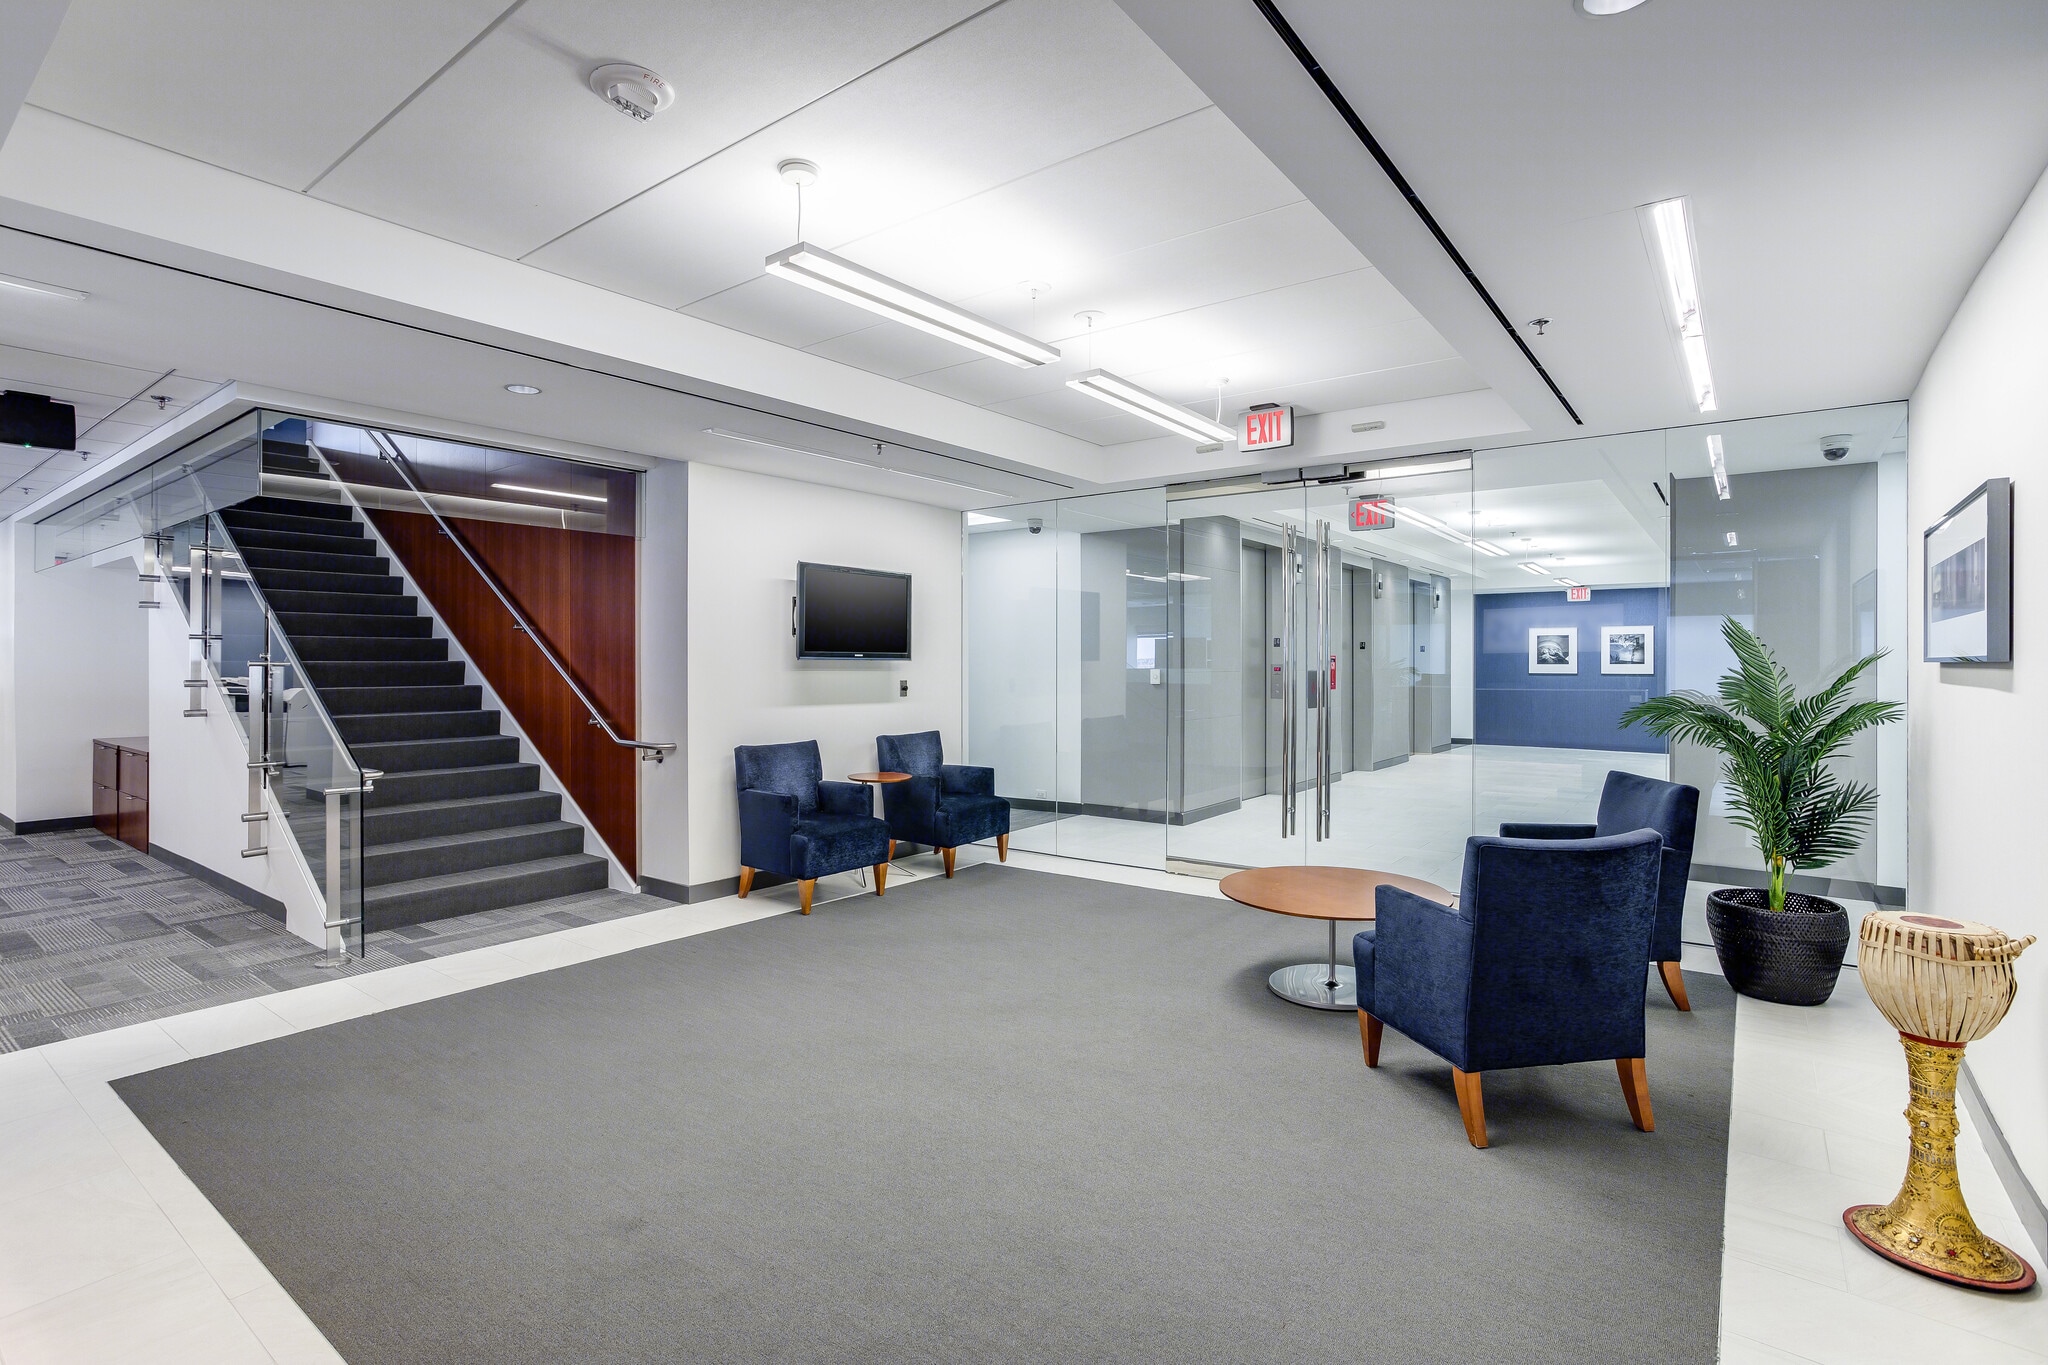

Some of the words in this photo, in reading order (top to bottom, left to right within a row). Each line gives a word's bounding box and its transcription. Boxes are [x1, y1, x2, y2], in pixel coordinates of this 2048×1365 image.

[643, 74, 665, 88] FIRE
[1246, 410, 1284, 445] EXIT
[1355, 499, 1387, 527] EXIT
[1571, 587, 1588, 600] EXIT
